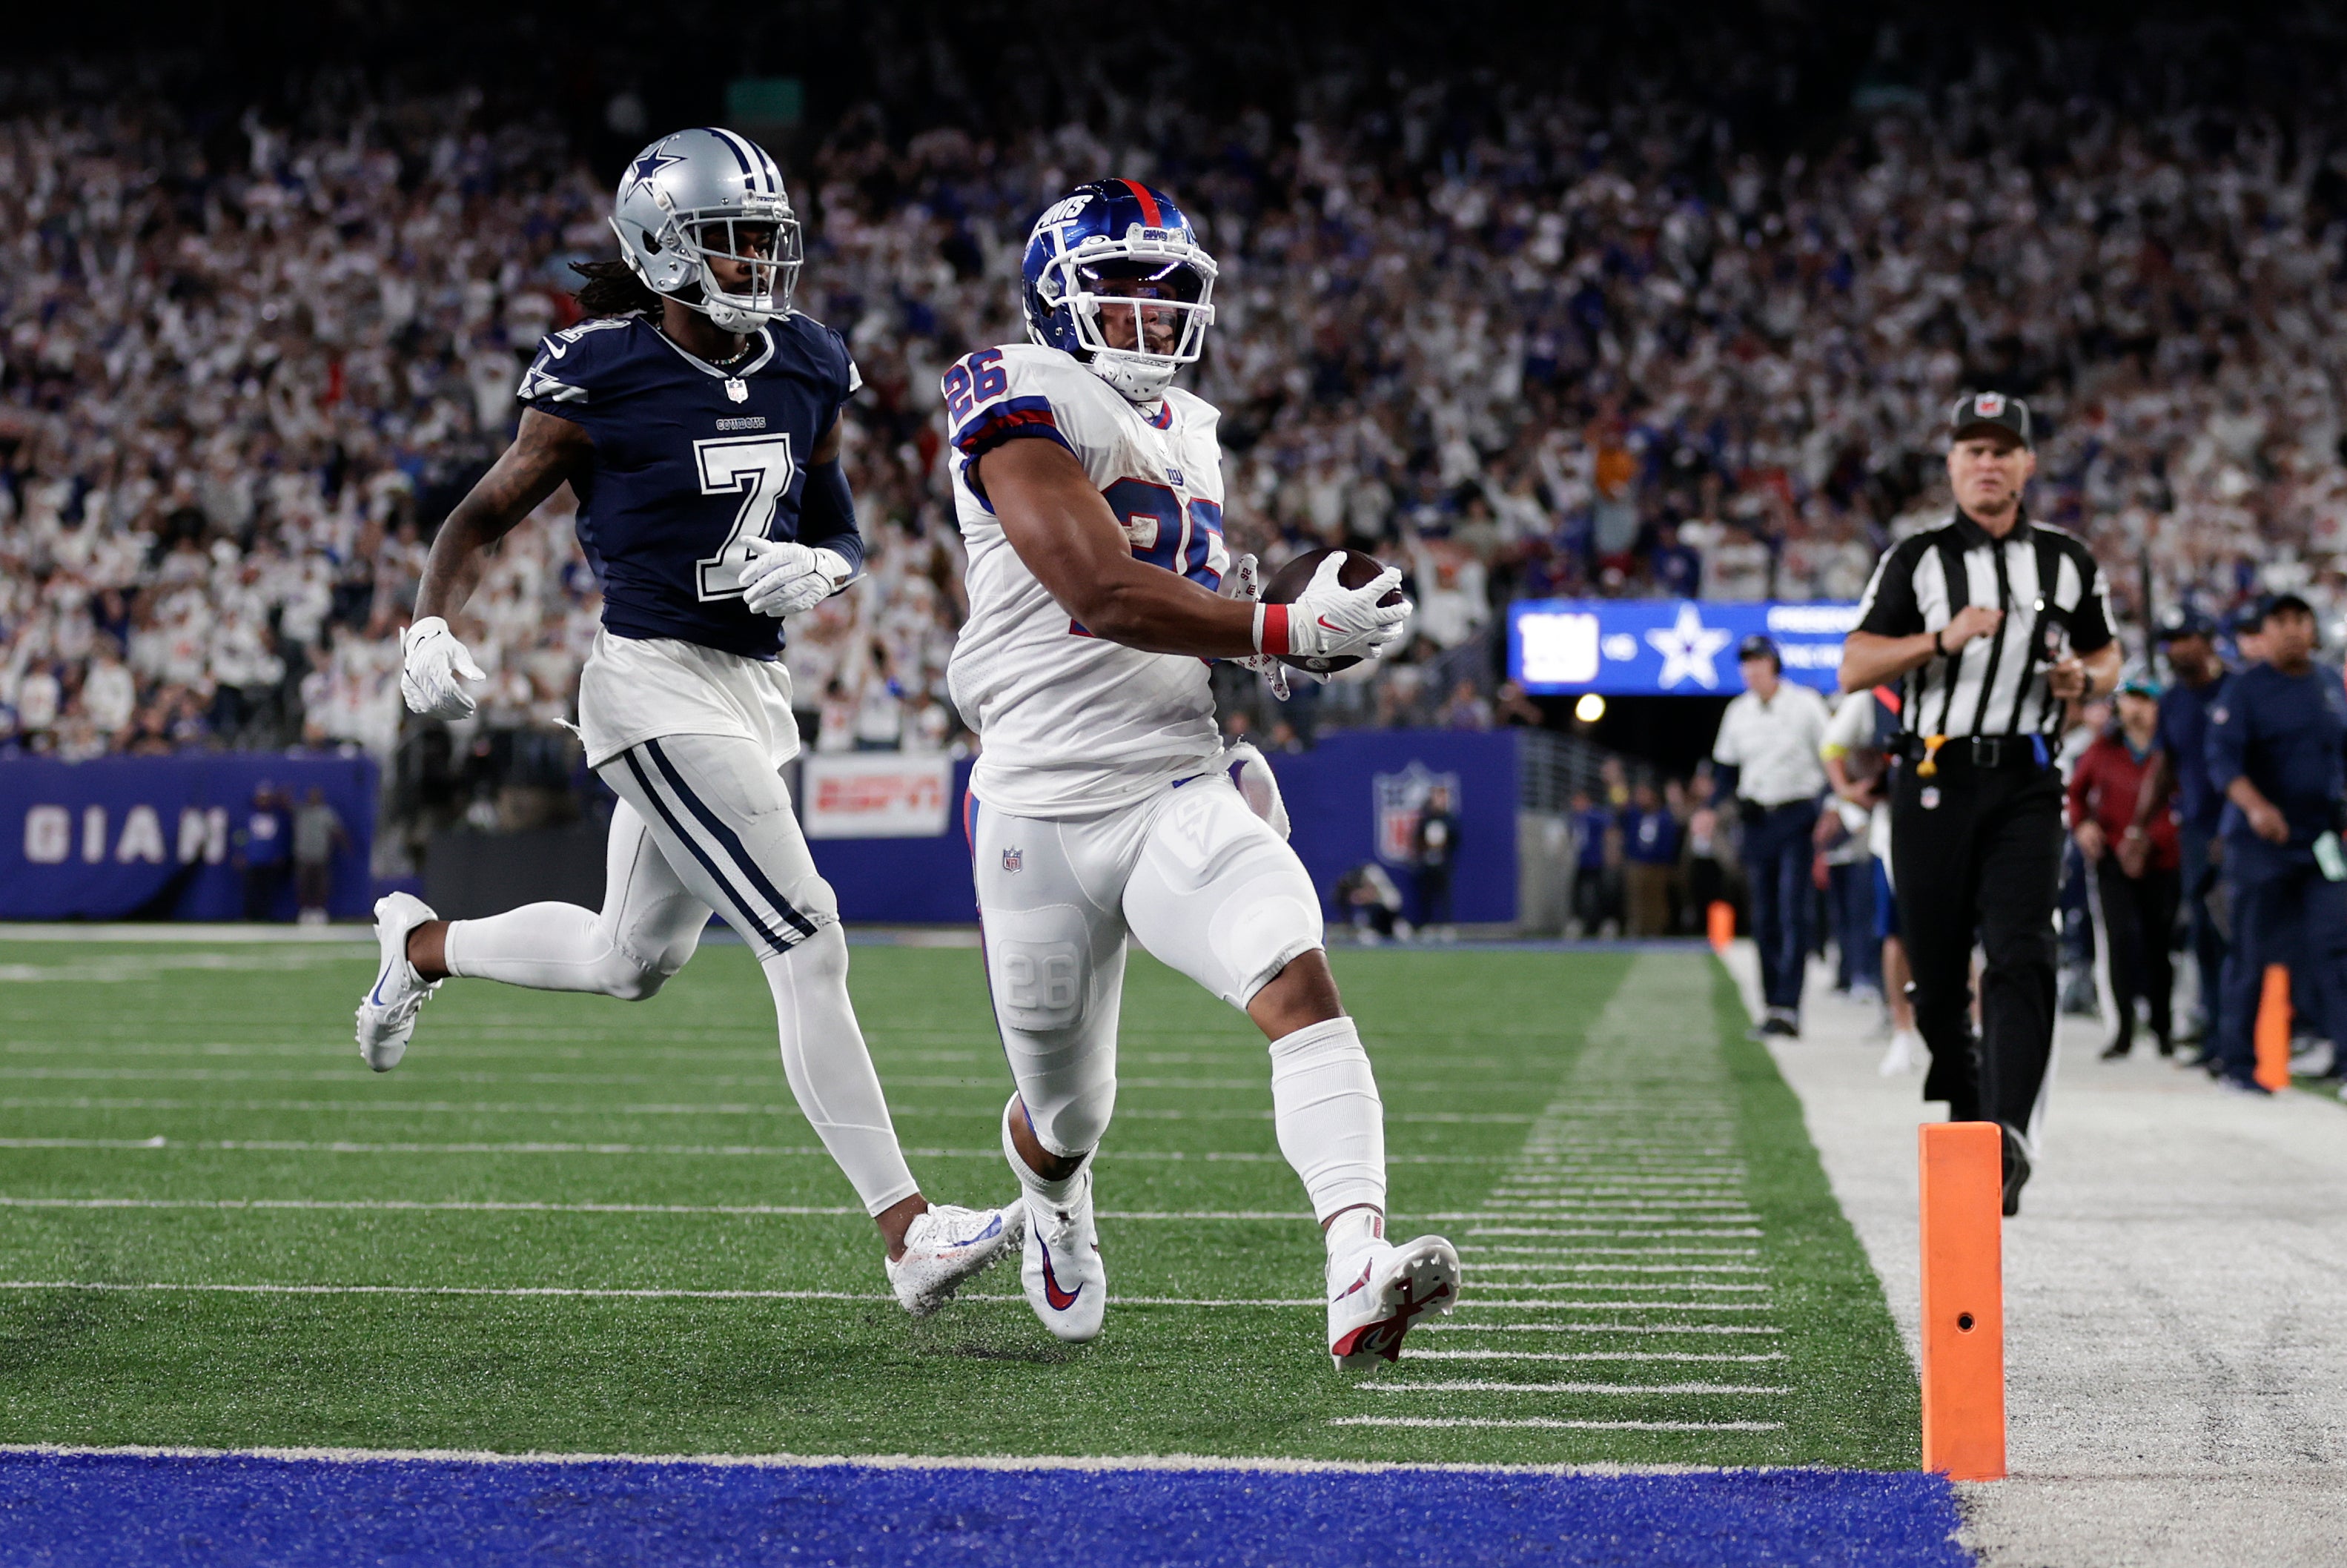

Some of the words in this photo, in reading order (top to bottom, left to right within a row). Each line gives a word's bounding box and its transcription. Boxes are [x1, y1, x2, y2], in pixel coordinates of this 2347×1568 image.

[943, 347, 1007, 427] 26
[716, 417, 766, 430] COWBOYS
[693, 433, 794, 602] 7
[1004, 953, 1075, 1009] 26
